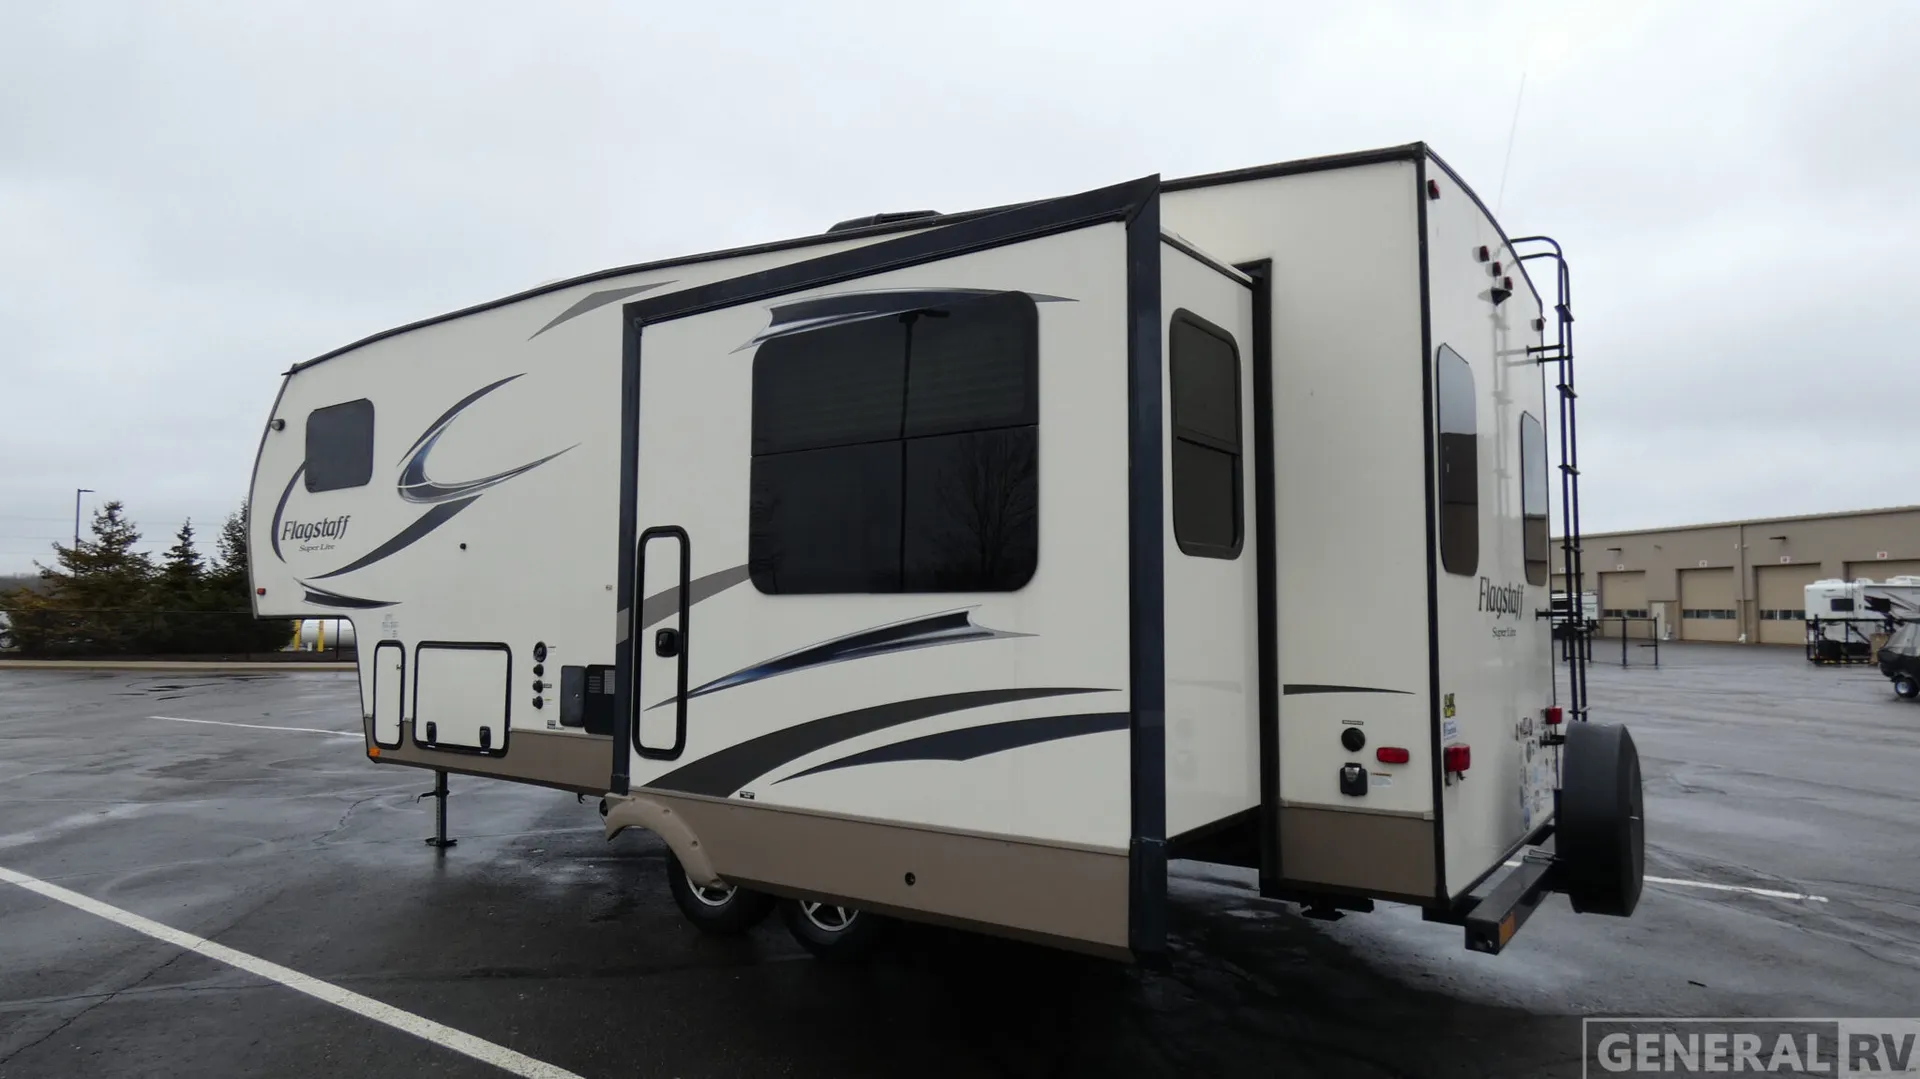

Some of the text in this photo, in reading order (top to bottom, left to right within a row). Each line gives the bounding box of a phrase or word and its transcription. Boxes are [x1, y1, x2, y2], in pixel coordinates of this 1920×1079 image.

[281, 515, 351, 542] Flagstaff
[299, 544, 319, 552] Super
[1479, 576, 1524, 620] Flagstaff
